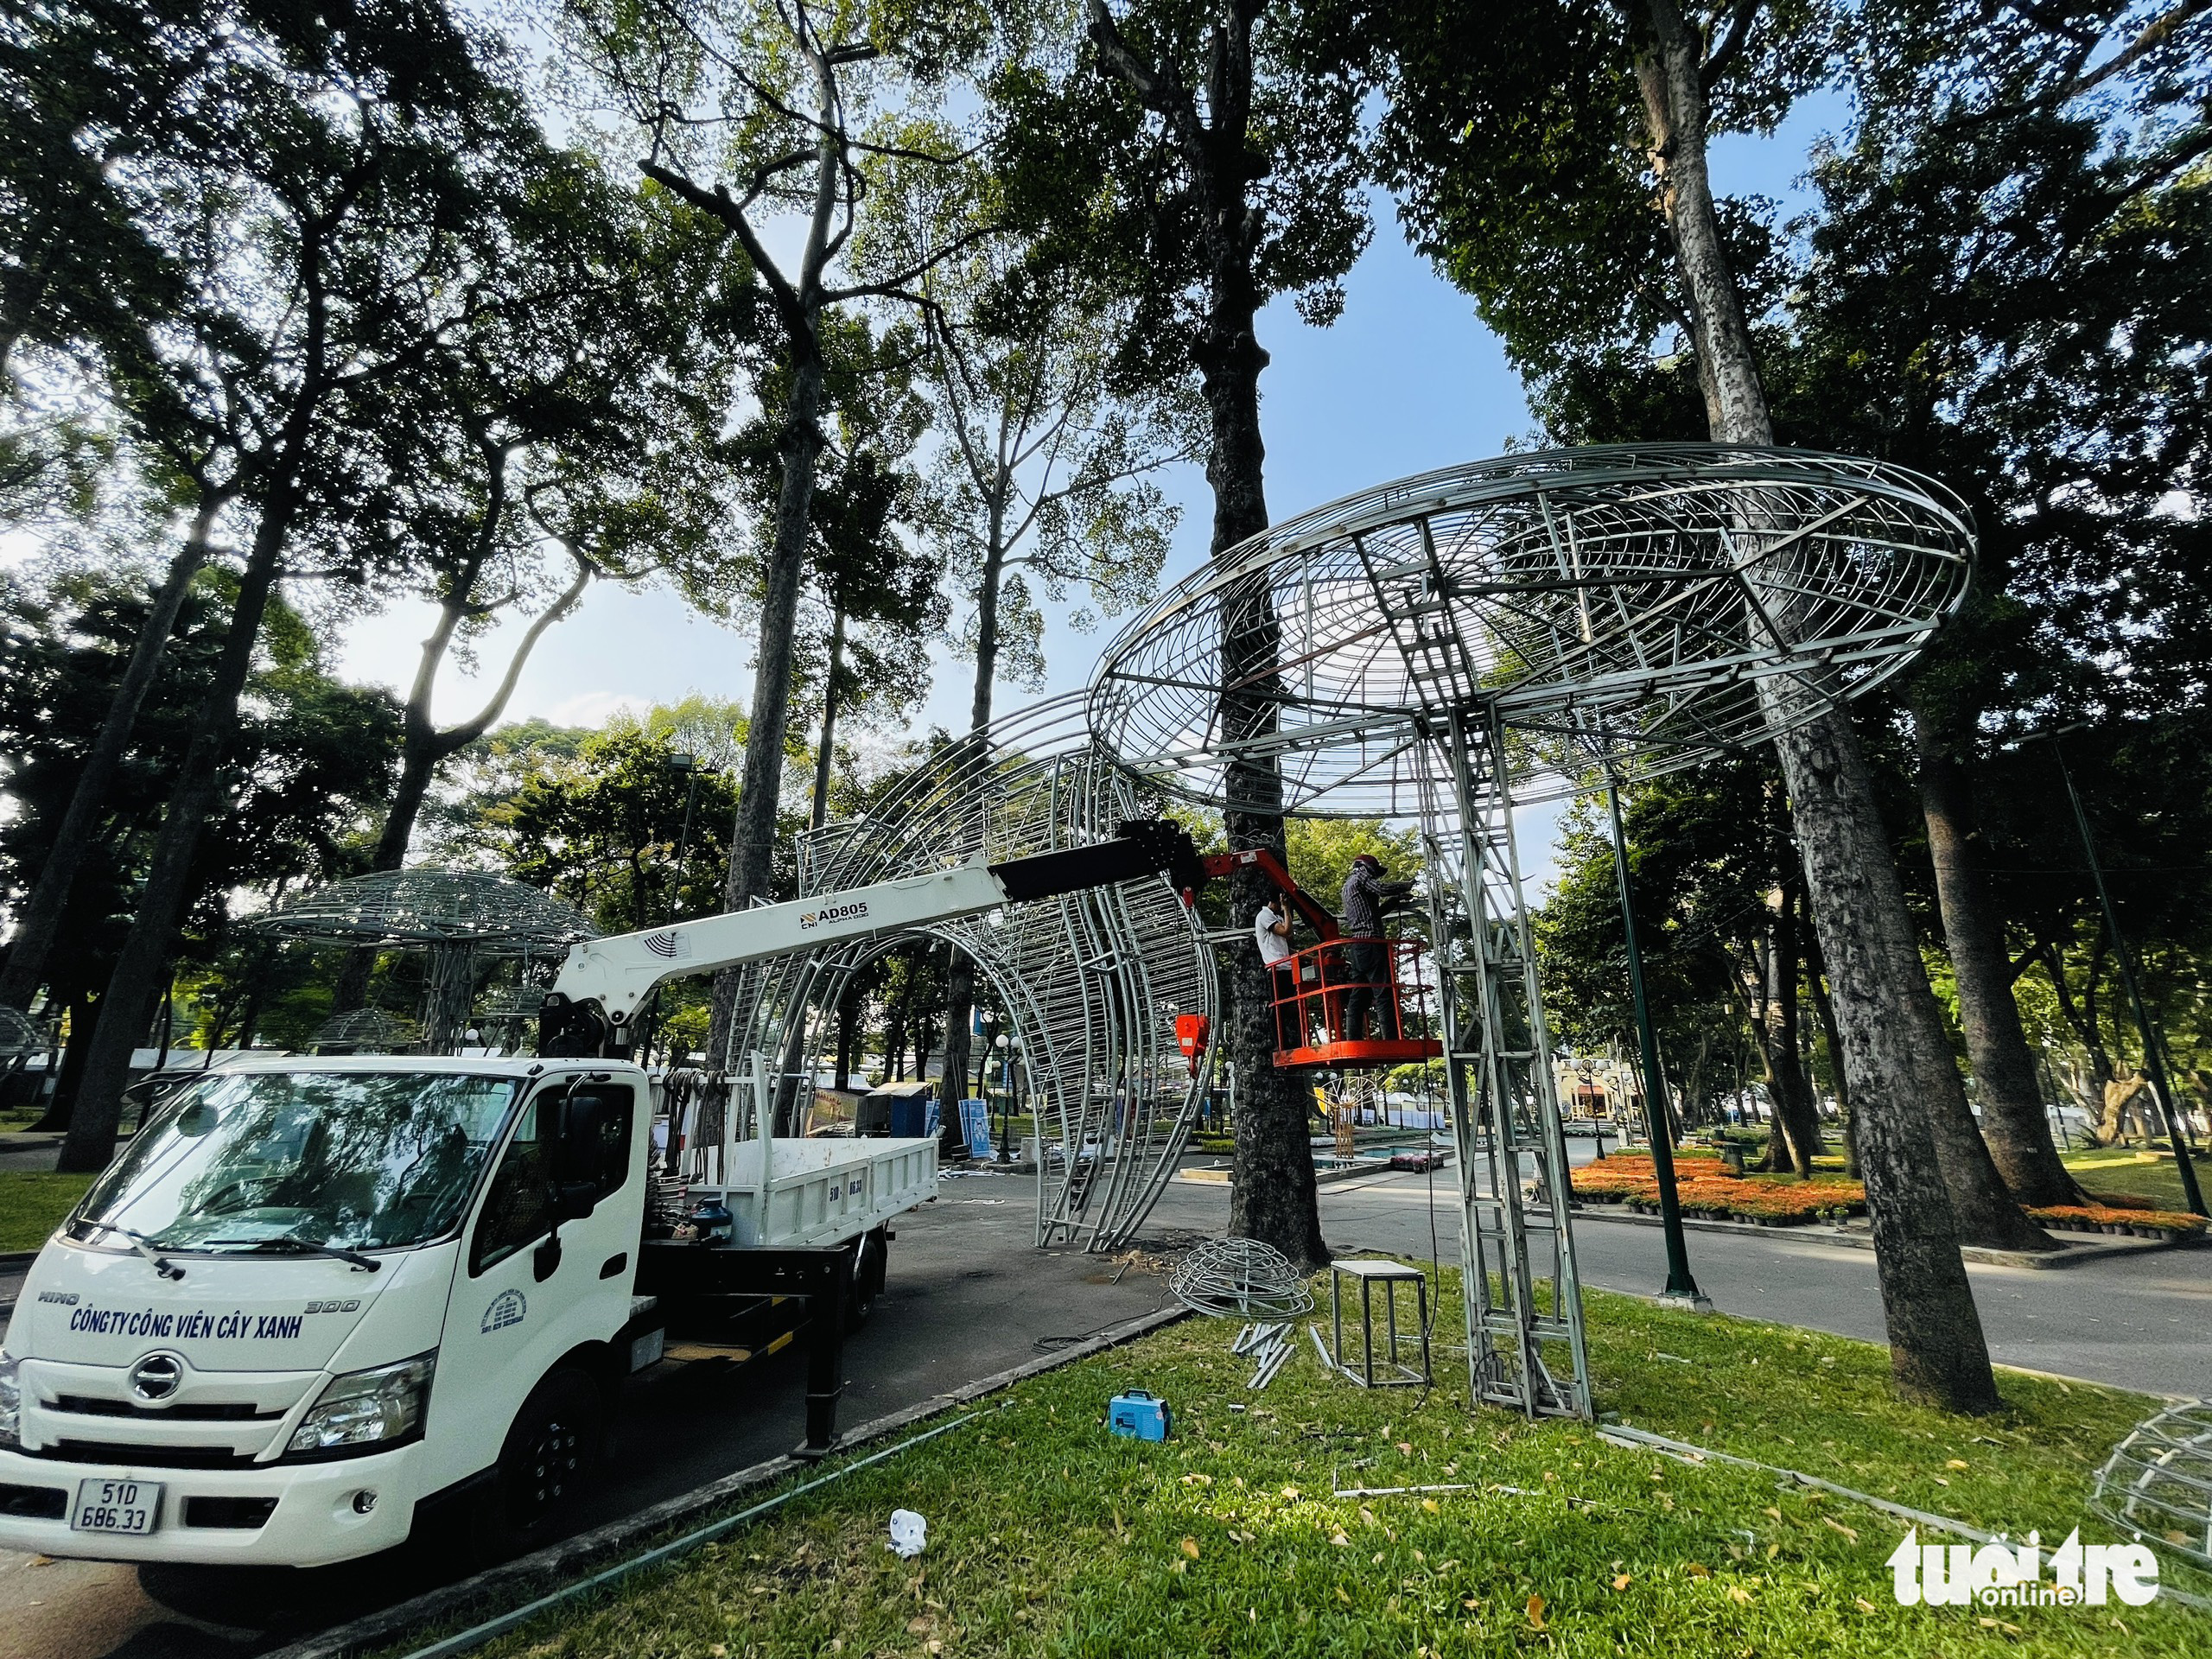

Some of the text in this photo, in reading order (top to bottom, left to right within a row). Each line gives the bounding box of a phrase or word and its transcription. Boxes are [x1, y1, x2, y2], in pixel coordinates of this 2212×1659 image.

[818, 902, 868, 921] AD805
[37, 1291, 80, 1306] HINO
[303, 1300, 361, 1314] 300
[70, 1303, 111, 1333] CÔNG
[128, 1308, 173, 1338] CÔNG
[175, 1310, 215, 1338] VIÊN
[217, 1310, 252, 1338] CÂY
[253, 1315, 303, 1339] XANH
[101, 1483, 137, 1504] 51D
[80, 1506, 146, 1530] 686.33
